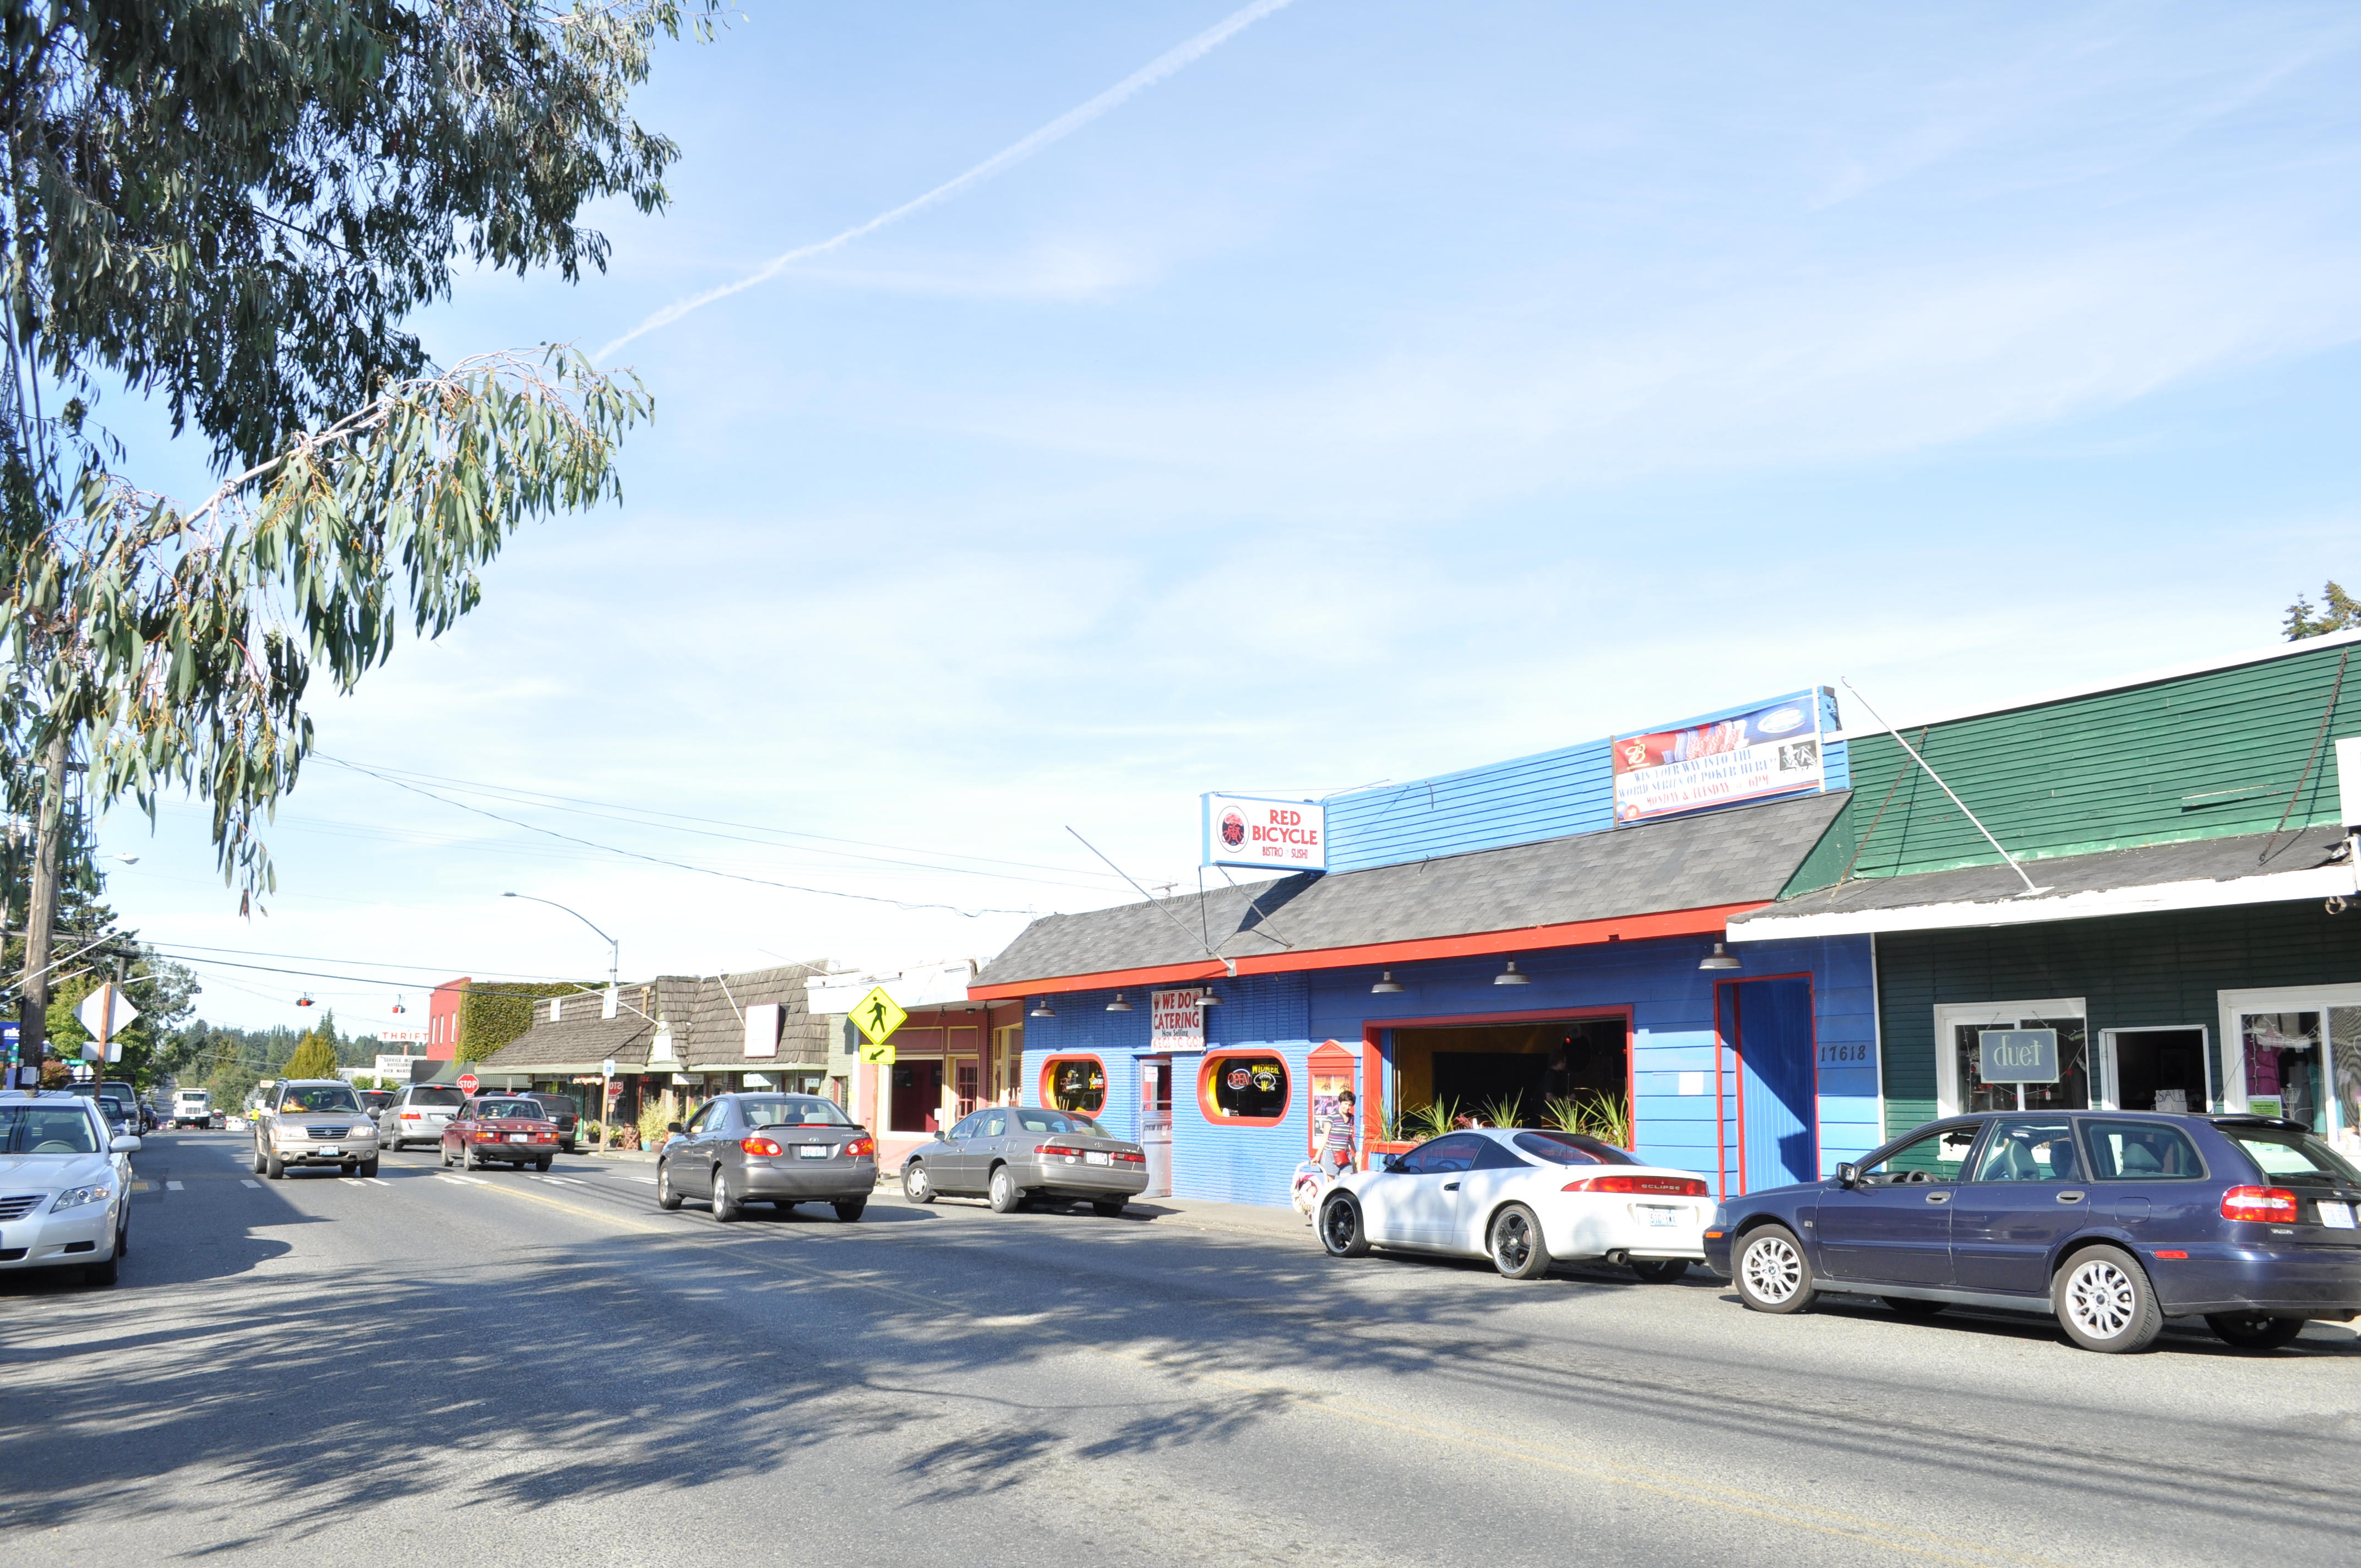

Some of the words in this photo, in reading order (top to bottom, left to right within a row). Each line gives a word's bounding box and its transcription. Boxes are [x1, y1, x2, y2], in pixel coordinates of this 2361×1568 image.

[1634, 770, 1650, 782] WIN
[1655, 764, 1680, 778] YOUR
[1682, 760, 1700, 772] WAY
[1705, 754, 1728, 769] INTO
[1733, 749, 1752, 763] THE
[1618, 783, 1649, 798] WORLD
[1687, 773, 1699, 785] OF
[1701, 765, 1737, 782] POKER
[1646, 791, 1679, 807] MONDAY
[1682, 792, 1689, 801] &
[1693, 782, 1731, 799] TUESDAY
[1748, 774, 1770, 788] 6PM
[1270, 809, 1301, 826] RED
[1253, 825, 1318, 845] BICYCLE
[1263, 846, 1283, 858] BISTRO
[1291, 848, 1308, 859] SUSHI
[1162, 993, 1176, 1010] WE
[1178, 992, 1192, 1009] DO
[1154, 1011, 1200, 1030] CATERING
[382, 1032, 429, 1041] THRIFT
[1153, 1037, 1171, 1048] KEGS
[1173, 1037, 1183, 1048] TO
[1821, 1044, 1866, 1062] 17618
[1993, 1035, 2043, 1066] duet
[1252, 1064, 1281, 1074] WIDMER
[459, 1080, 477, 1088] STOP
[1228, 1072, 1250, 1086] OPEN
[2158, 1090, 2186, 1103] SALE
